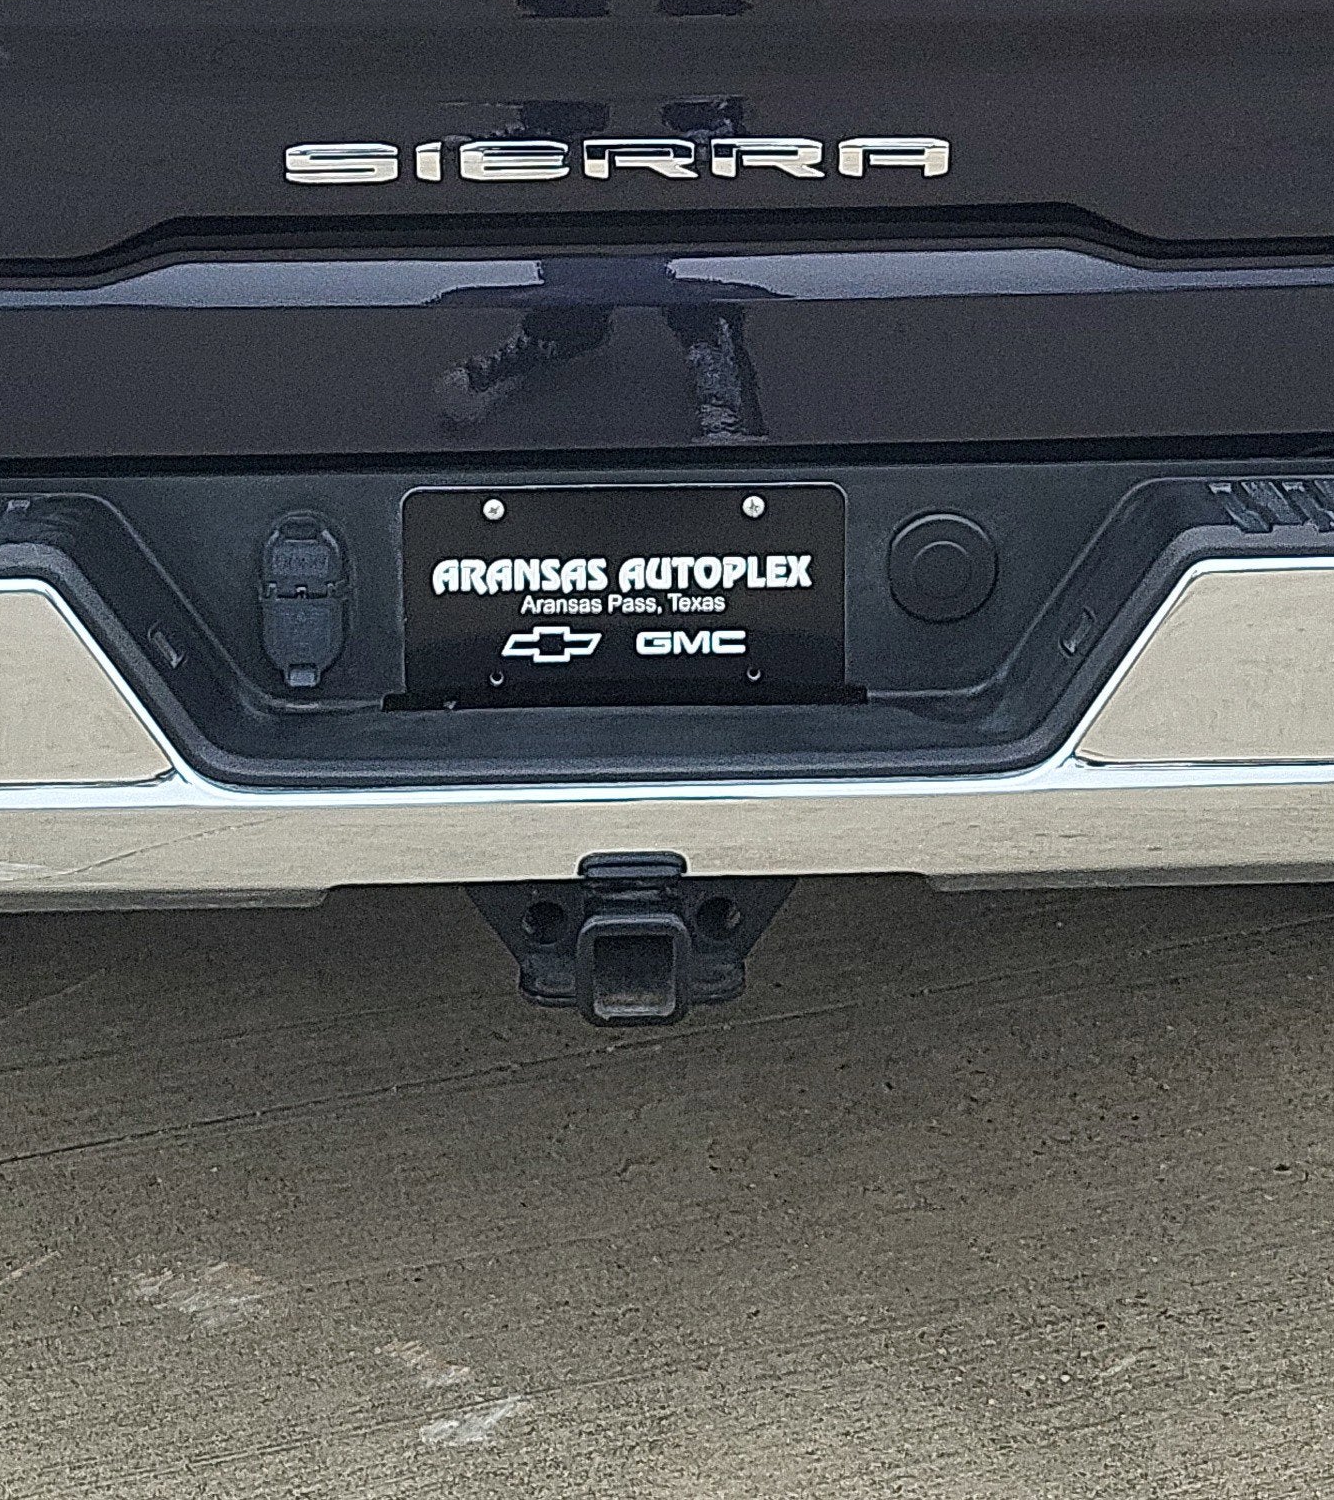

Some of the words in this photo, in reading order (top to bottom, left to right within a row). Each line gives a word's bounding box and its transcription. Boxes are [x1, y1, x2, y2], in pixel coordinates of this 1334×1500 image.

[285, 137, 950, 184] SIERRA
[431, 557, 609, 596] ARANSAS
[617, 554, 813, 593] AUTOPLEX
[520, 595, 603, 615] Aransas
[607, 594, 663, 615] Pass,
[666, 593, 727, 613] Texas
[635, 629, 747, 656] GMC
